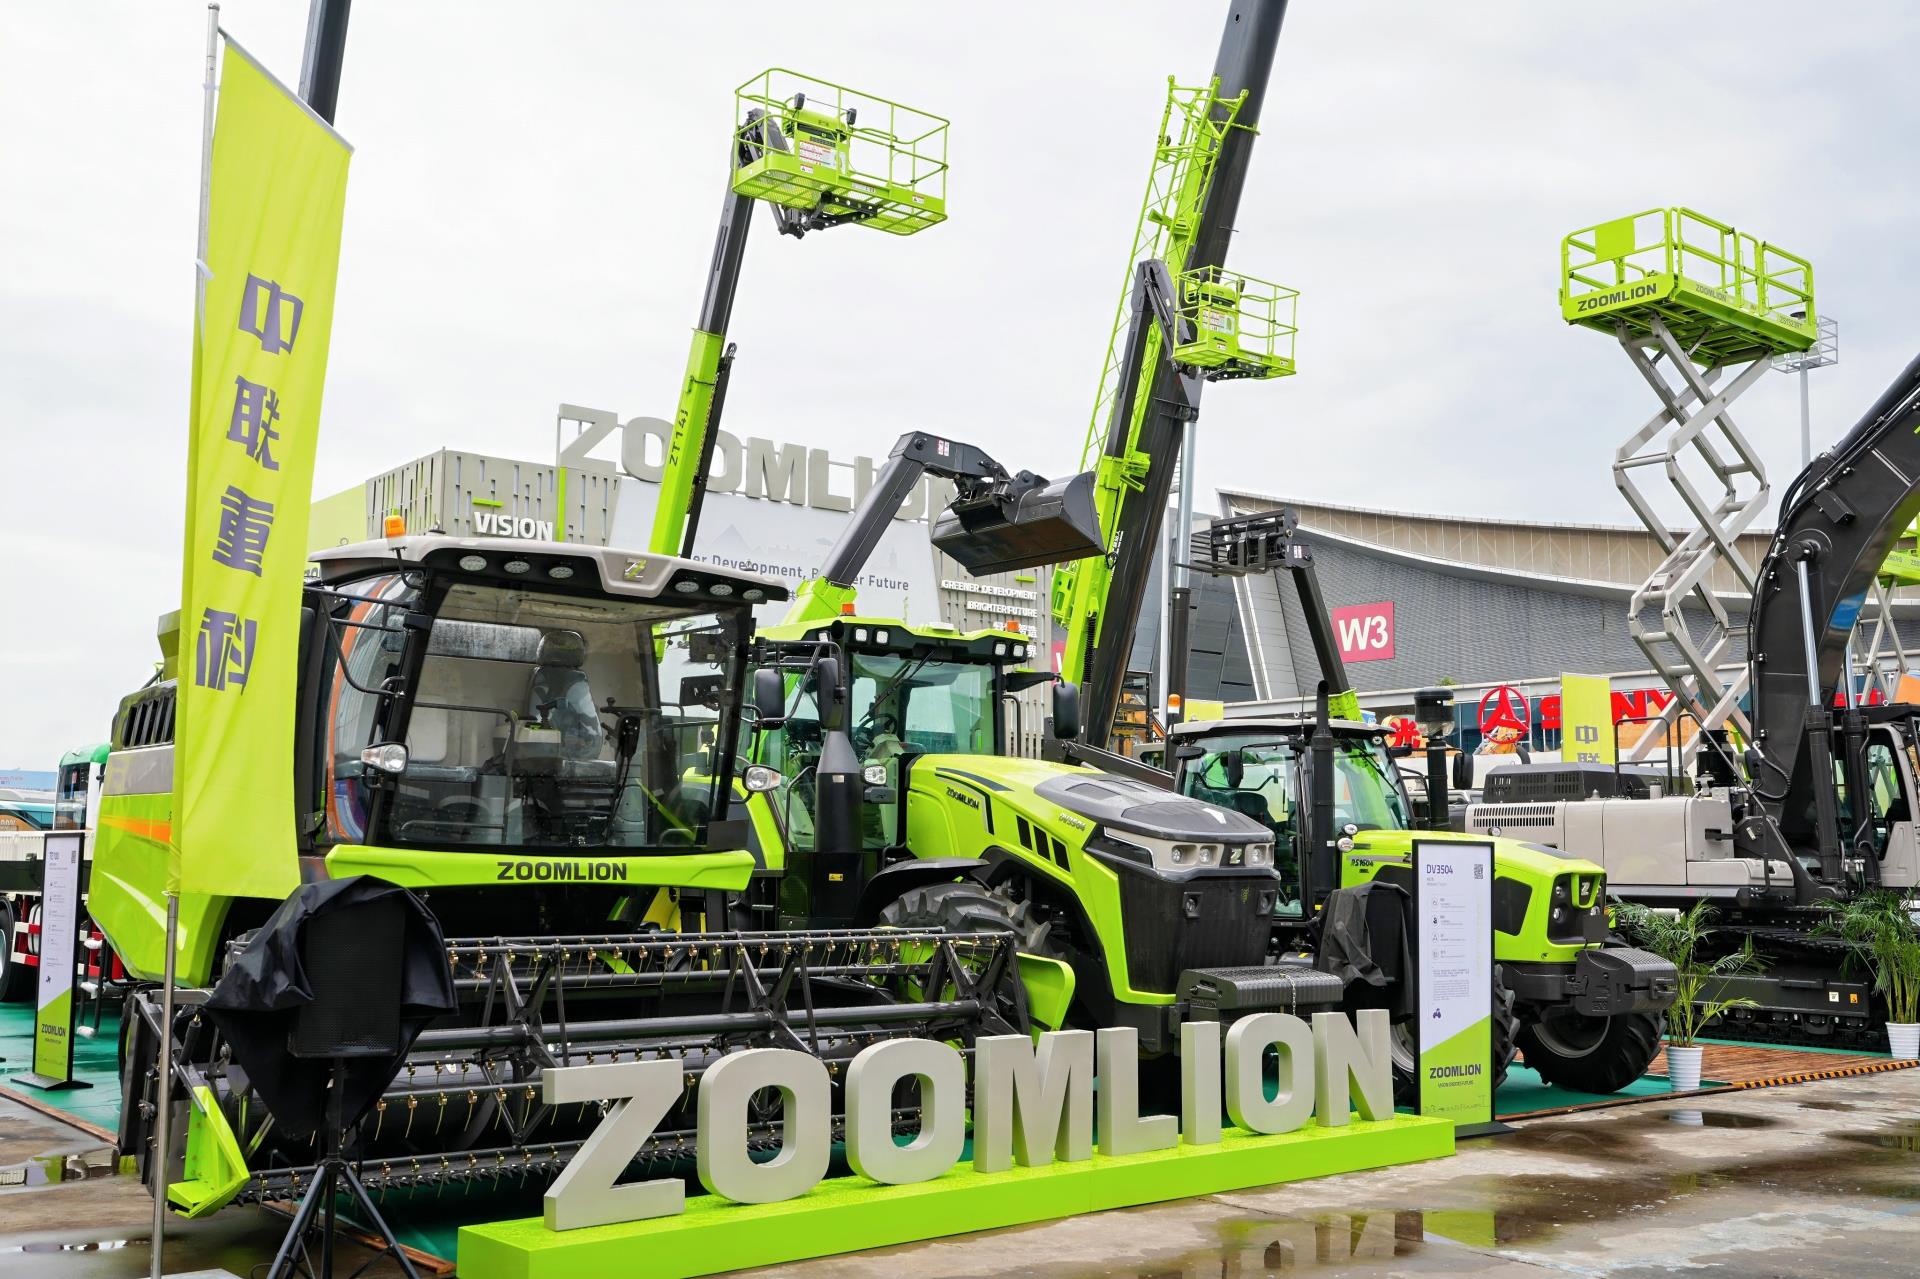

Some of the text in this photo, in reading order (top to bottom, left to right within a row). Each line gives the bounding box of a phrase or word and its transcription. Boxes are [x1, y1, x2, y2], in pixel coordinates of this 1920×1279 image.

[1577, 283, 1658, 313] ZOOMLION
[195, 272, 304, 696] 中联重科
[473, 511, 554, 541] VISION
[868, 574, 910, 591] Future
[942, 580, 1038, 600] GREENER DEVELOPMENT
[967, 600, 1038, 618] BRIGHTER FUTURE
[1338, 615, 1389, 652] W3
[1539, 688, 1677, 730] SNY
[946, 786, 980, 811] ZOOMLION
[496, 861, 628, 882] ZOOMLION
[1426, 864, 1454, 875] DV3504
[1429, 1063, 1482, 1080] ZOOMLION
[542, 1008, 1395, 1231] ZOOMLION
